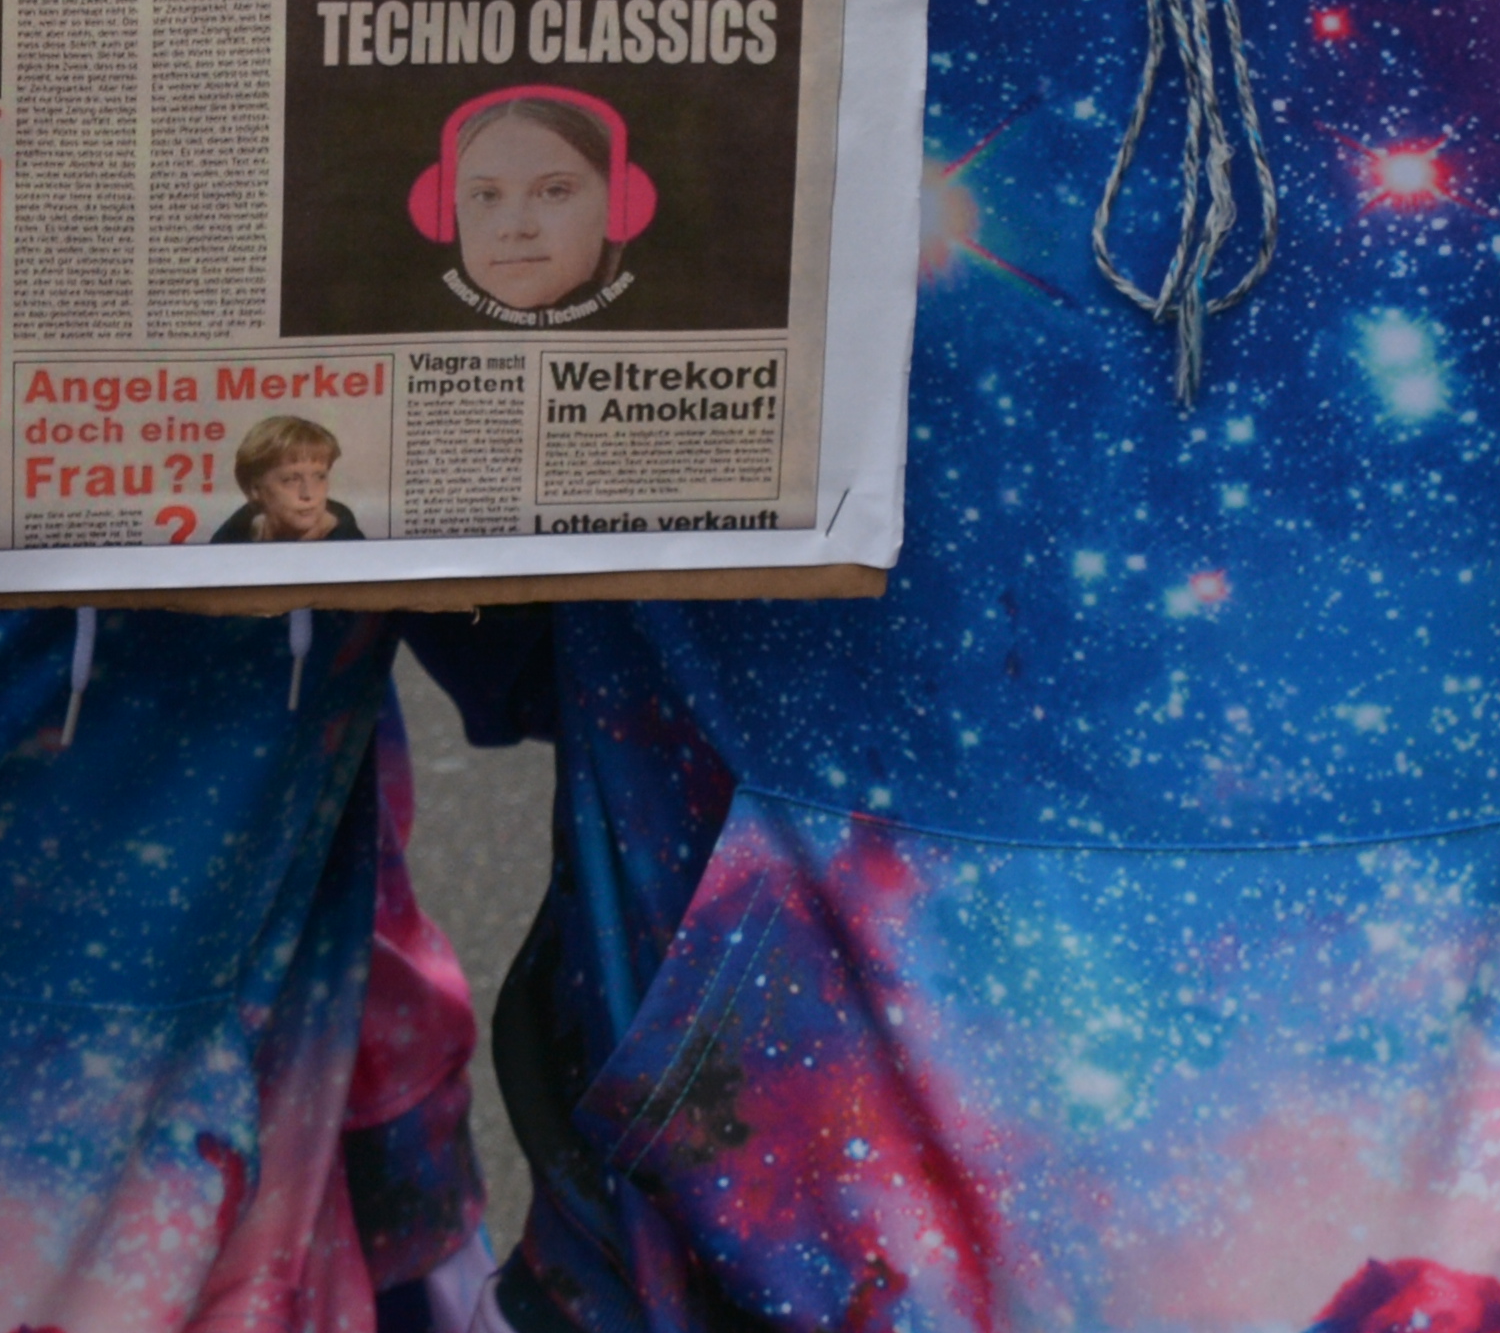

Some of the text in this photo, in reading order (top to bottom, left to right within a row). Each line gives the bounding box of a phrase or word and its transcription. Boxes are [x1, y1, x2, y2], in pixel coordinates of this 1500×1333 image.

[318, 0, 515, 65] TECHNO
[443, 269, 635, 325] Dance Trance Techno Rave
[410, 353, 525, 373] Viagra macht
[550, 359, 777, 391] Weltrekord
[26, 362, 385, 413] Angela Merkel
[408, 376, 523, 396] impotent
[548, 396, 775, 423] im Amoklauf!
[25, 417, 226, 444] doch eine
[534, 510, 779, 535] Lotterie verkauft
